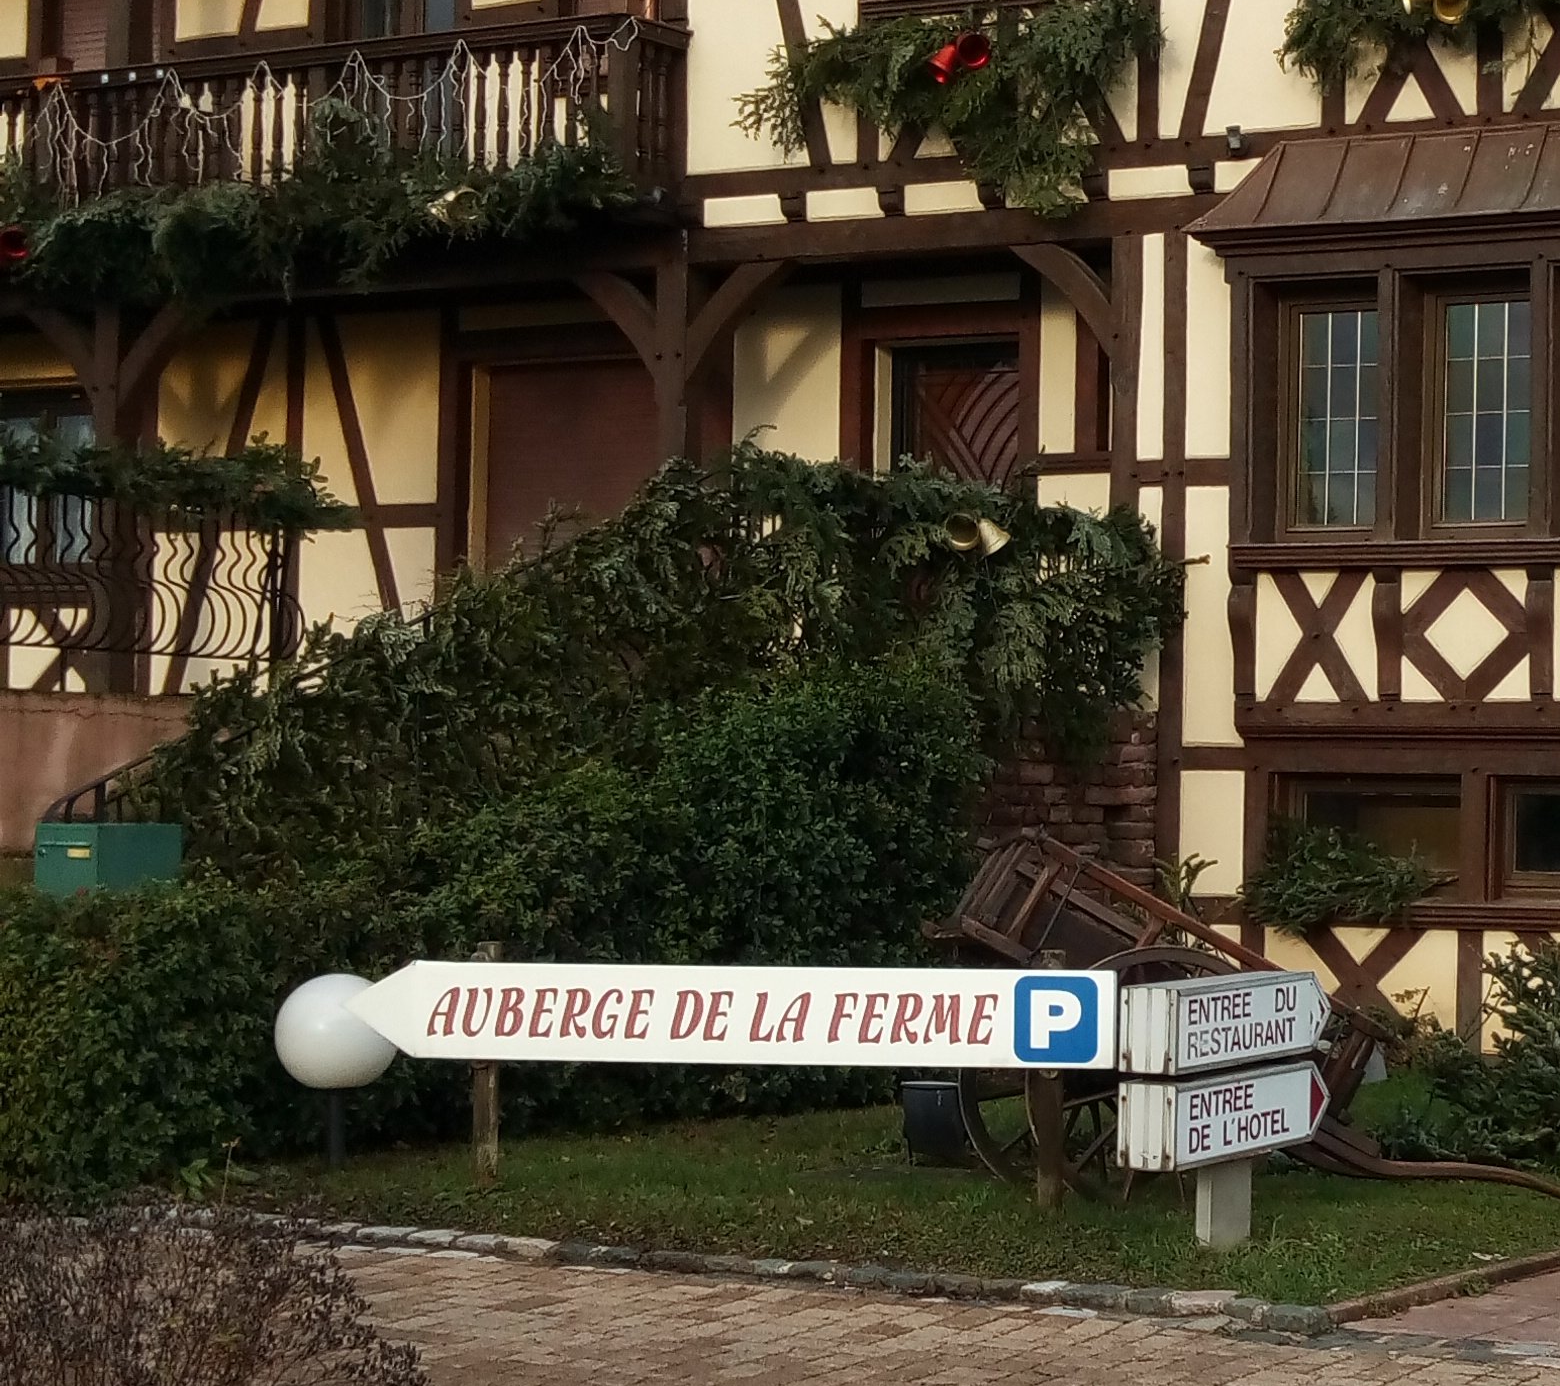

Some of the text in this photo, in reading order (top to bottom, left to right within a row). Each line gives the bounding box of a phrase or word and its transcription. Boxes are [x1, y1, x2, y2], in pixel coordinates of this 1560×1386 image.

[427, 986, 655, 1040] AUBERGE
[670, 989, 734, 1042] DE
[749, 991, 812, 1043] LA
[827, 992, 999, 1045] FERME
[1275, 986, 1297, 1013] DU
[1187, 1016, 1296, 1060] RESTAURANT
[1189, 1108, 1290, 1154] DE L'HOTEL
